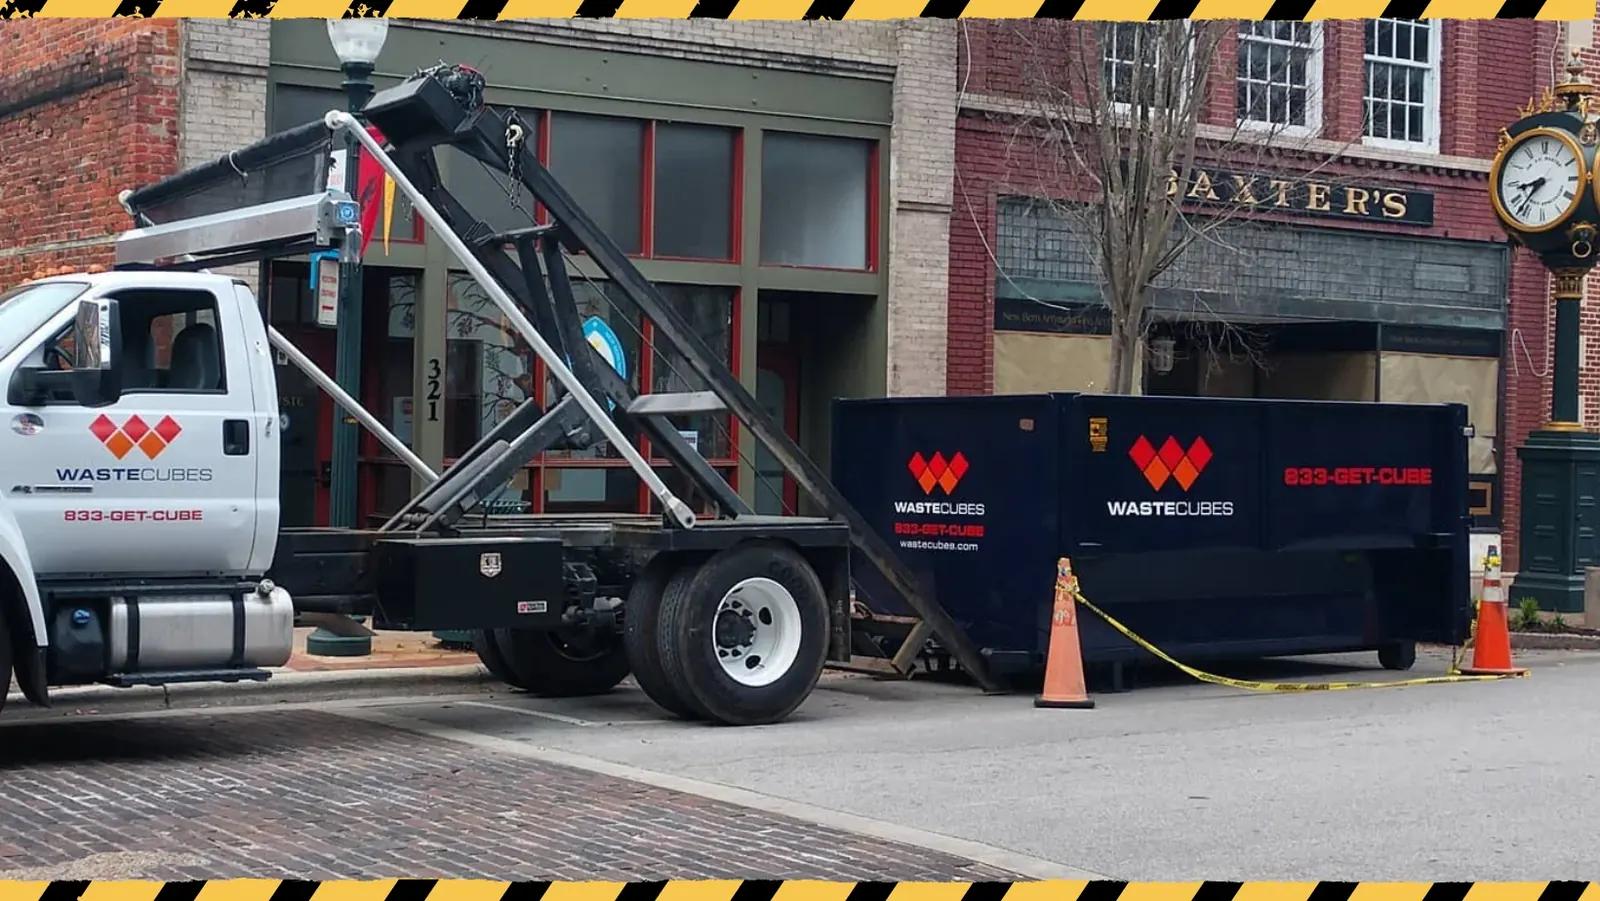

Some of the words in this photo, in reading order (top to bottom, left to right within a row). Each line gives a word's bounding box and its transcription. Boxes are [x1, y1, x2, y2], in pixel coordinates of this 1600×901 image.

[427, 358, 442, 421] 321
[56, 468, 213, 481] WASTECUBES
[1283, 467, 1433, 485] 833-GET-CUBE
[894, 501, 985, 515] WASTECUBES
[1107, 501, 1234, 516] WASTECUBES
[64, 510, 203, 521] 833-GET-CUBE
[894, 522, 985, 537] 833-GET-CUBE
[899, 539, 979, 551] wastecubes.com
